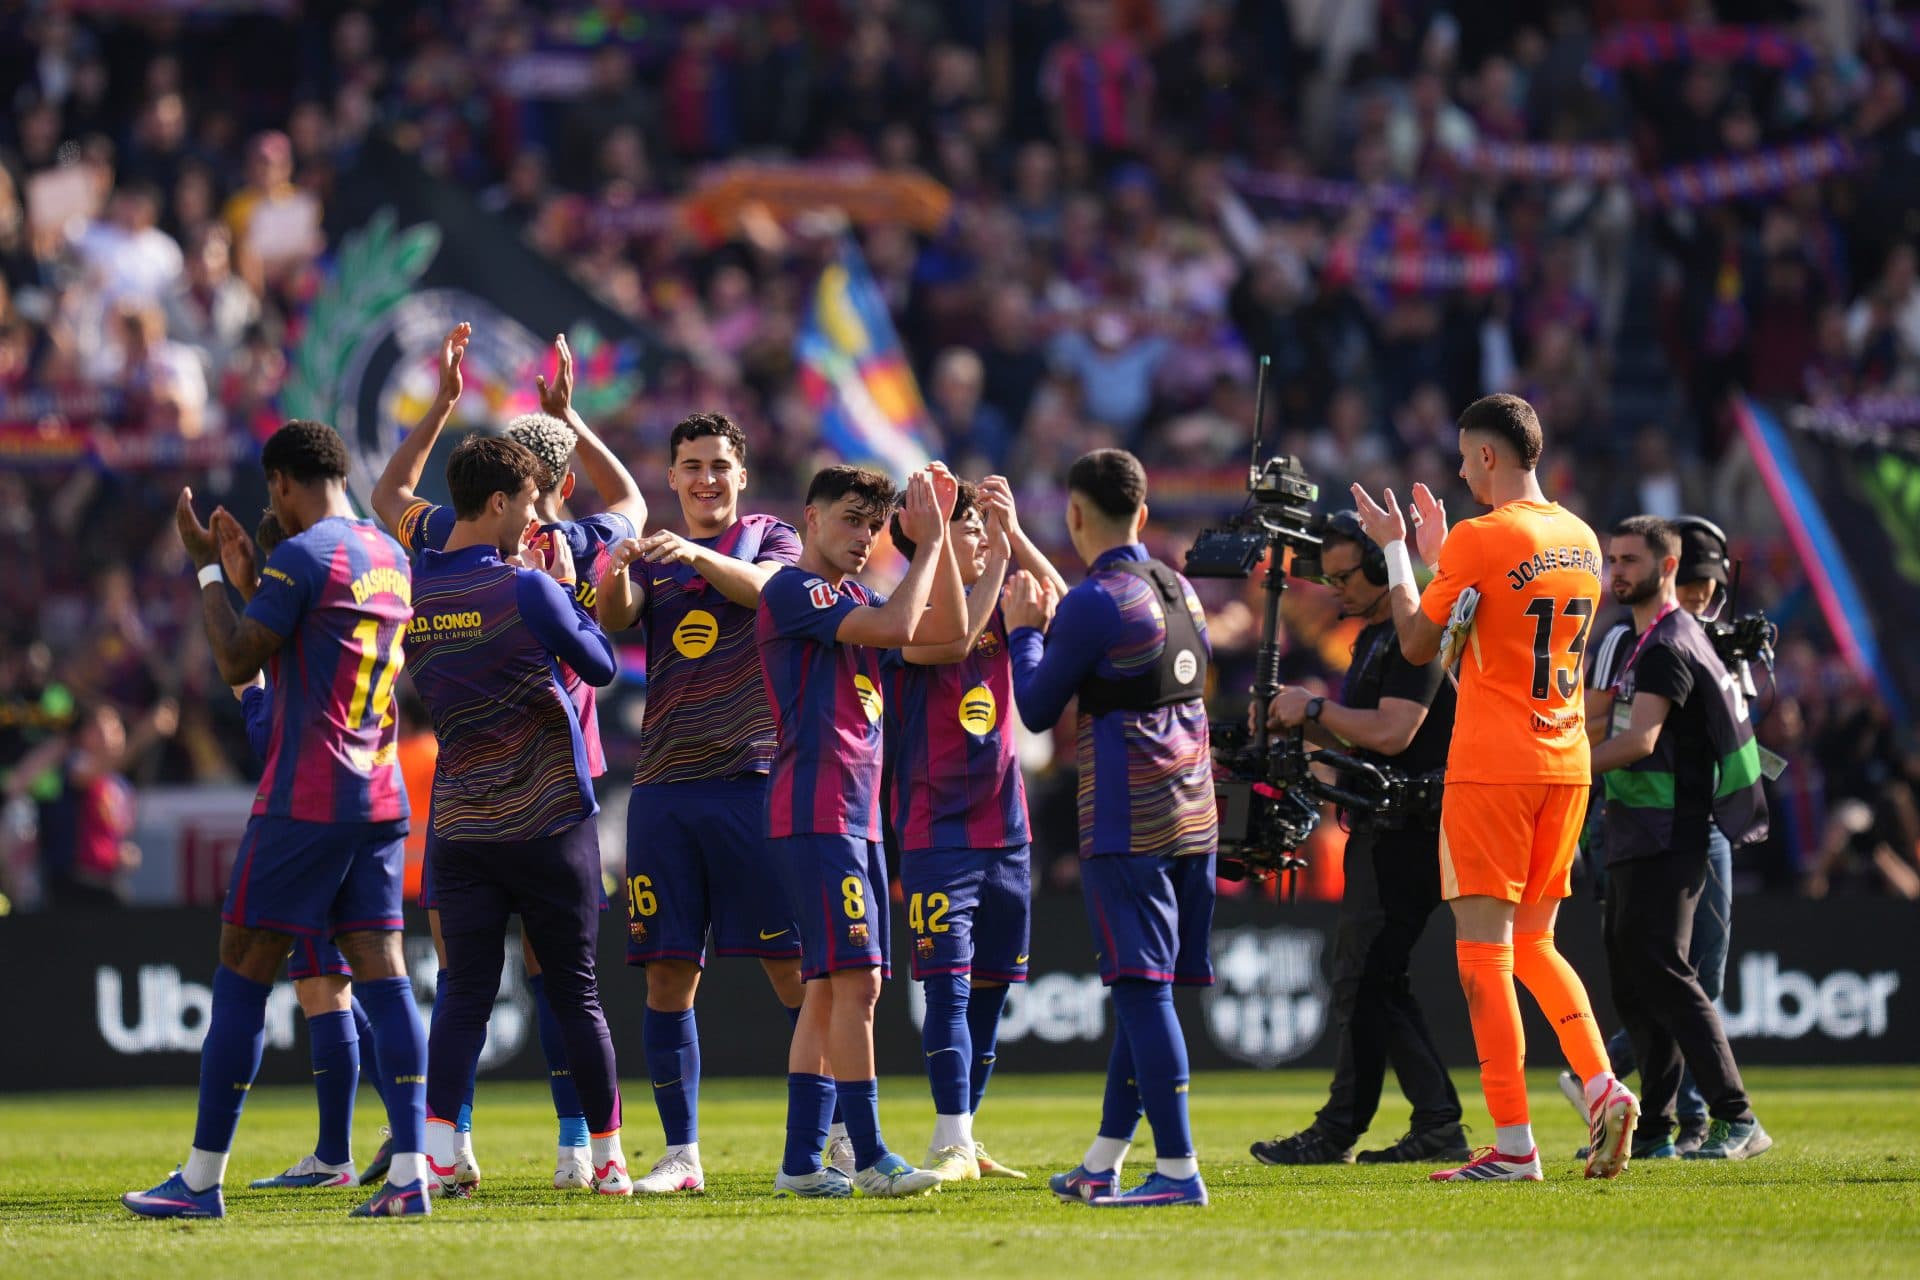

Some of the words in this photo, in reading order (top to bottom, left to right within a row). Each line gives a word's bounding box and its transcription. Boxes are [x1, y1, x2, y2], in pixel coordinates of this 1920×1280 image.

[351, 567, 411, 608] RASHFOR
[1506, 547, 1557, 591] JOAN
[432, 611, 482, 631] CONGO
[433, 632, 443, 640] DE
[445, 629, 482, 640] L'AFRIQUE
[1523, 597, 1593, 700] 13
[841, 876, 866, 919] 8
[909, 892, 950, 934] 42
[96, 964, 301, 1052] Ubr
[1712, 951, 1900, 1040] Uber
